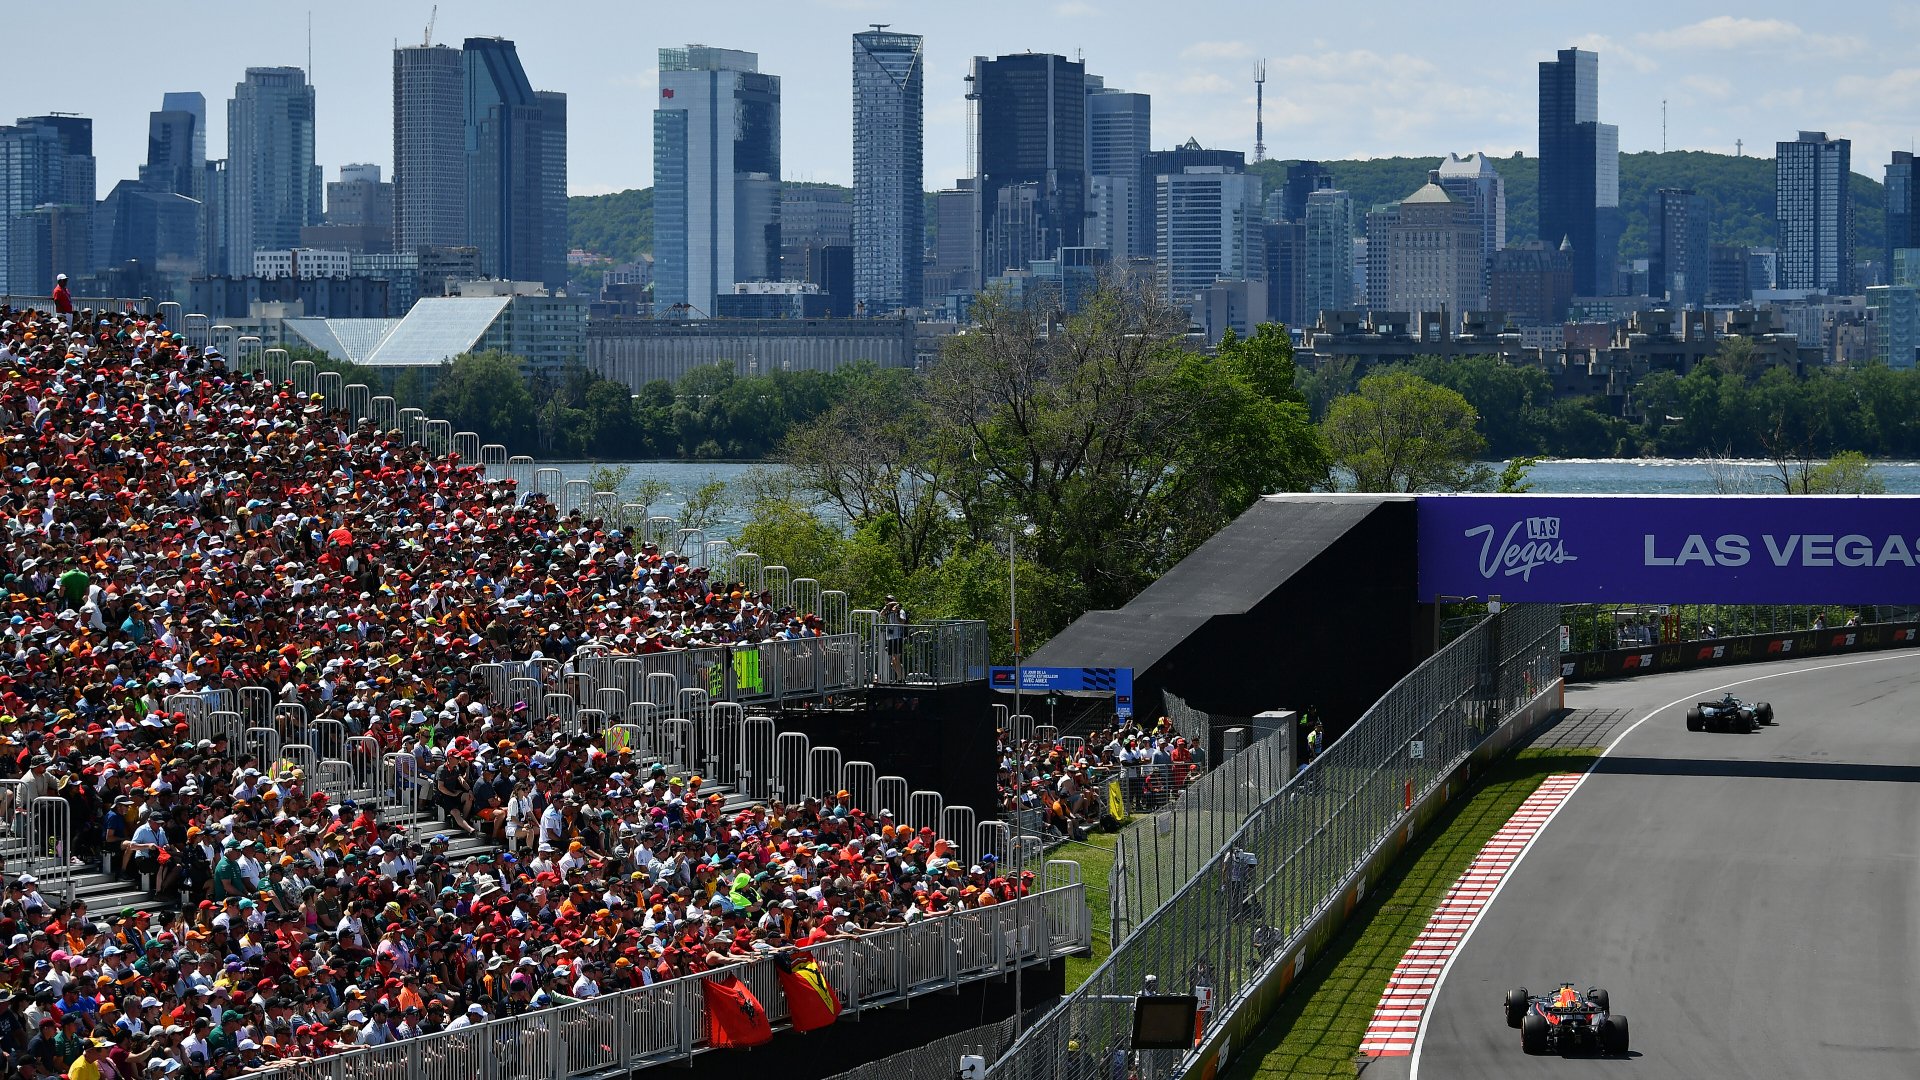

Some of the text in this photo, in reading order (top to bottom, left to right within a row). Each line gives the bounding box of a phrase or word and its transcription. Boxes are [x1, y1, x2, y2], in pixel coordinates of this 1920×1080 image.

[1529, 519, 1557, 537] LAS
[1464, 520, 1578, 583] Vegas
[1644, 534, 1920, 567] LAS VEGA
[1640, 654, 1653, 667] 75
[1713, 645, 1725, 658] 75
